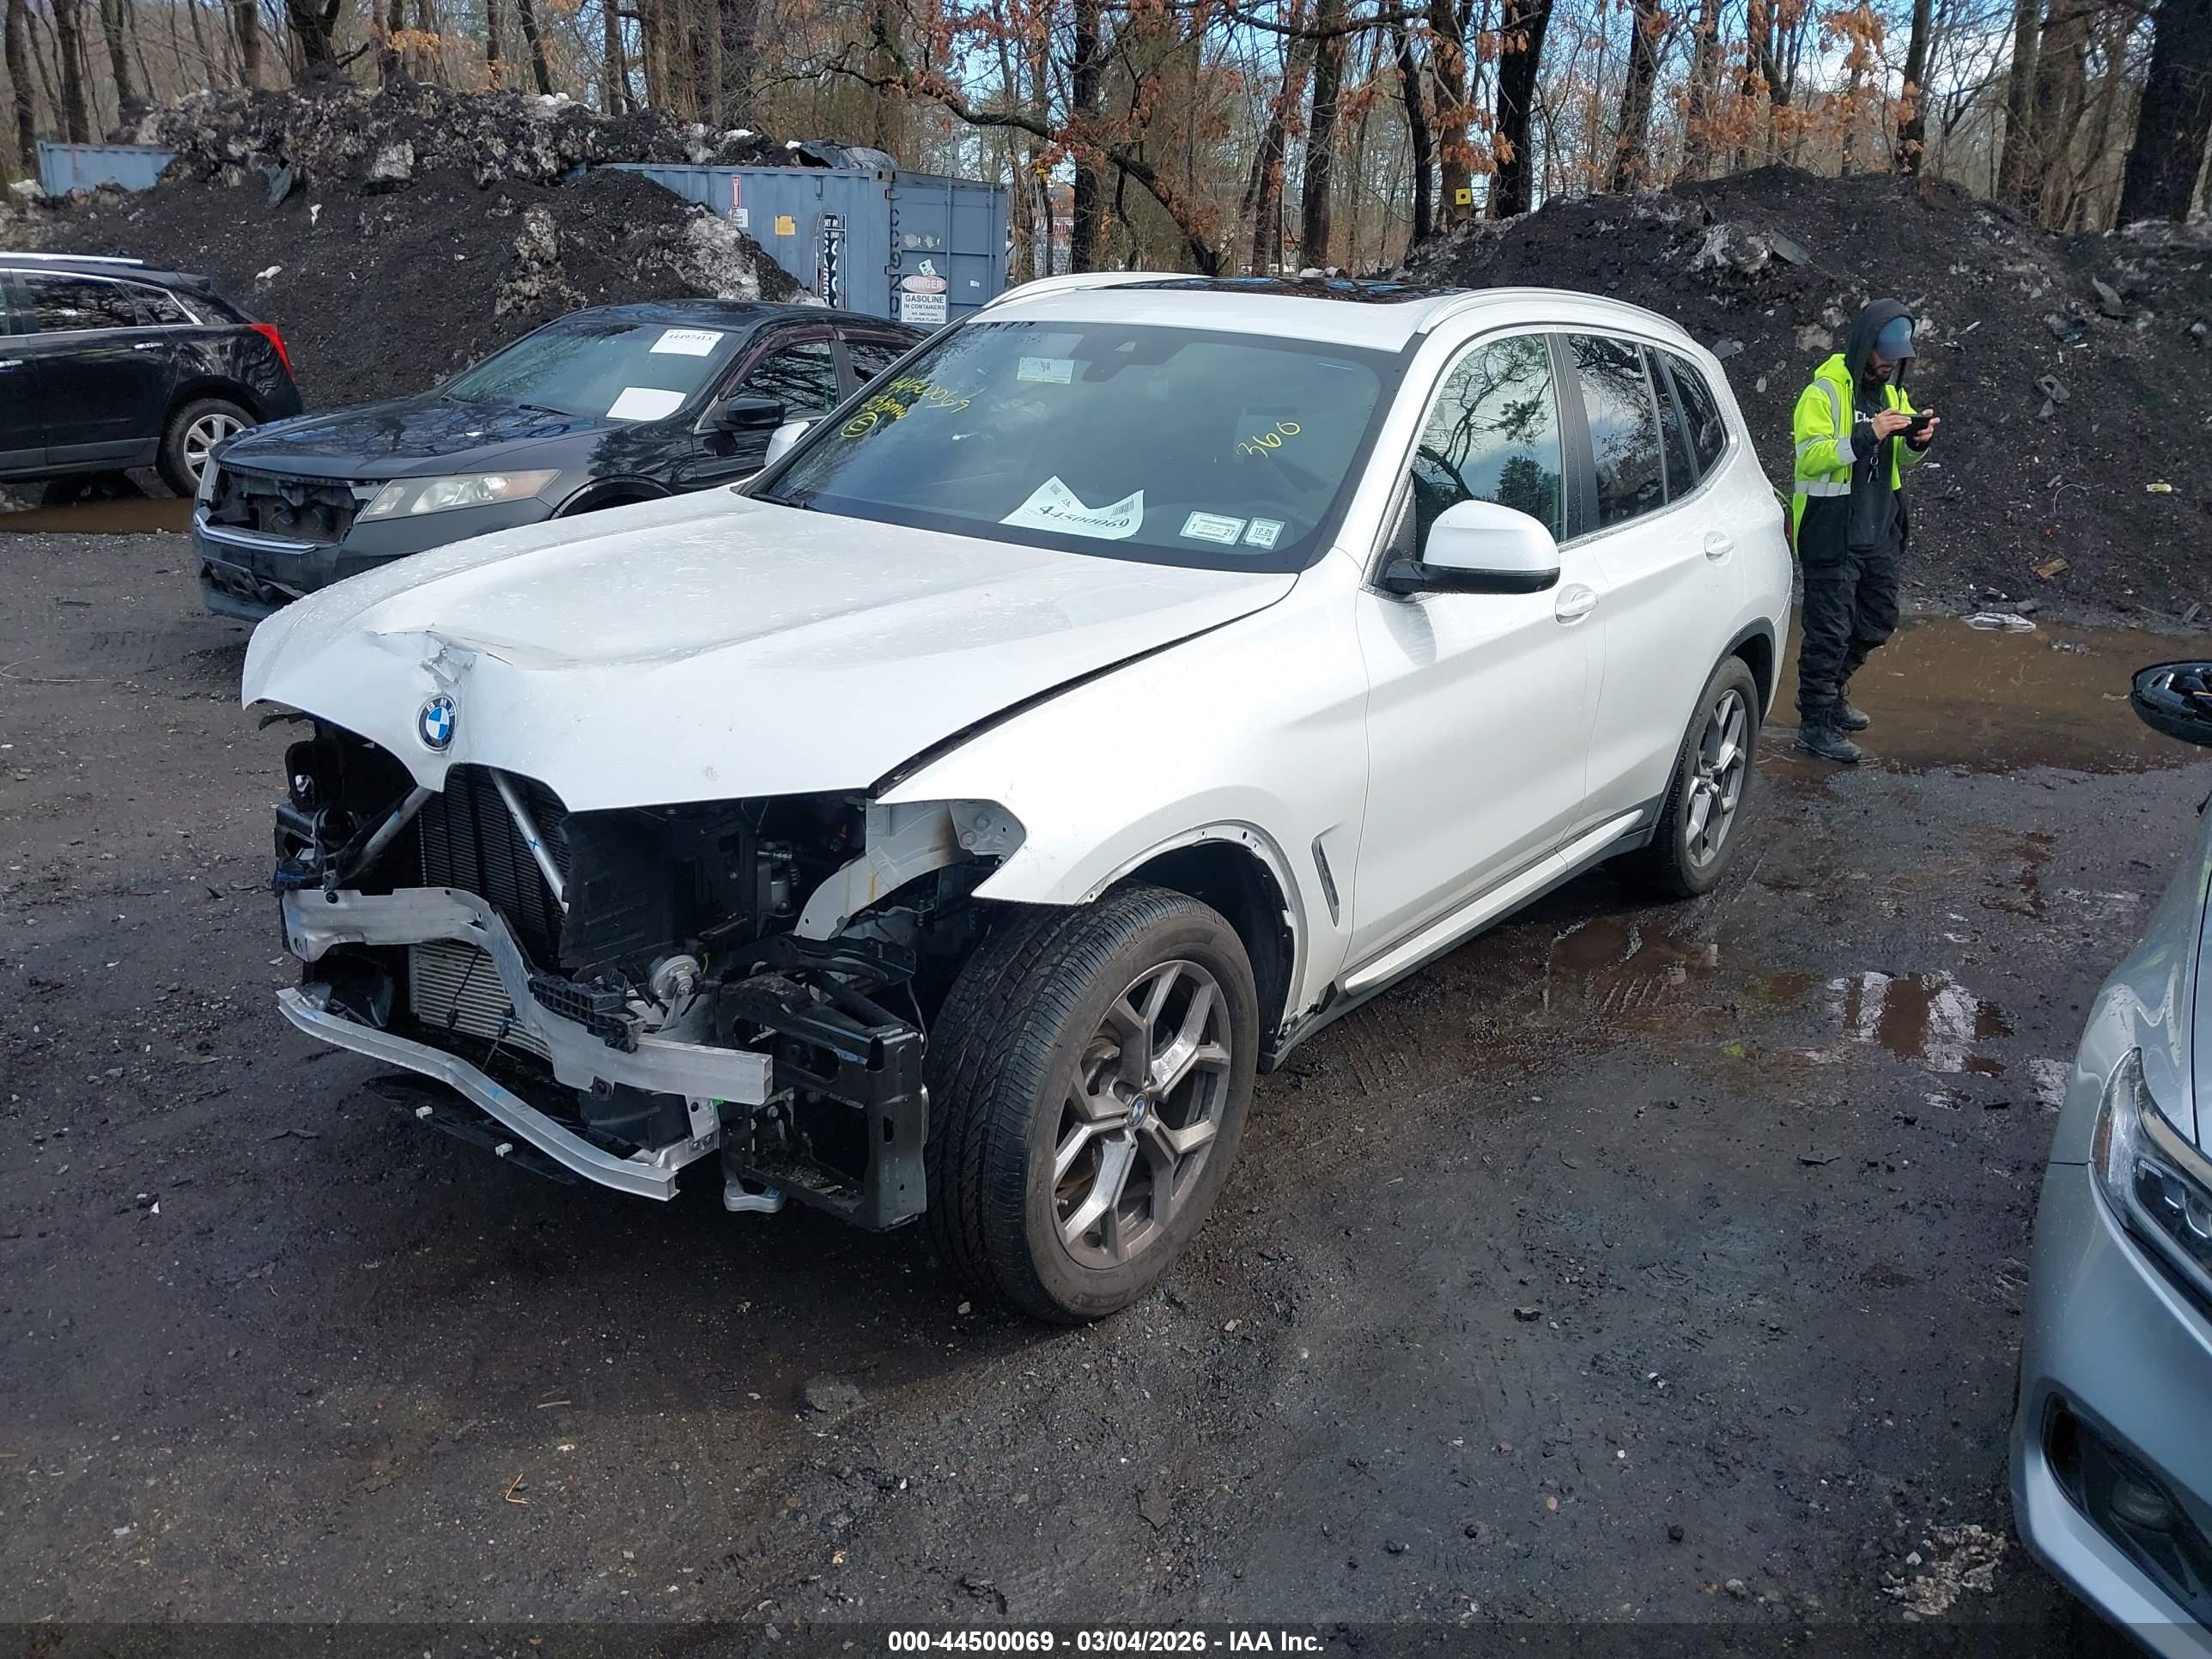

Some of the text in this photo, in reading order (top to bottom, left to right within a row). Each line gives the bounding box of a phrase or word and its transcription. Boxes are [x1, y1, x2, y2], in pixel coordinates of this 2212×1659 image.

[907, 278, 943, 289] DANGER
[905, 295, 945, 303] GASOLINE
[1237, 422, 1301, 459] 360
[1039, 506, 1130, 529] 44500069
[426, 697, 455, 717] BMW
